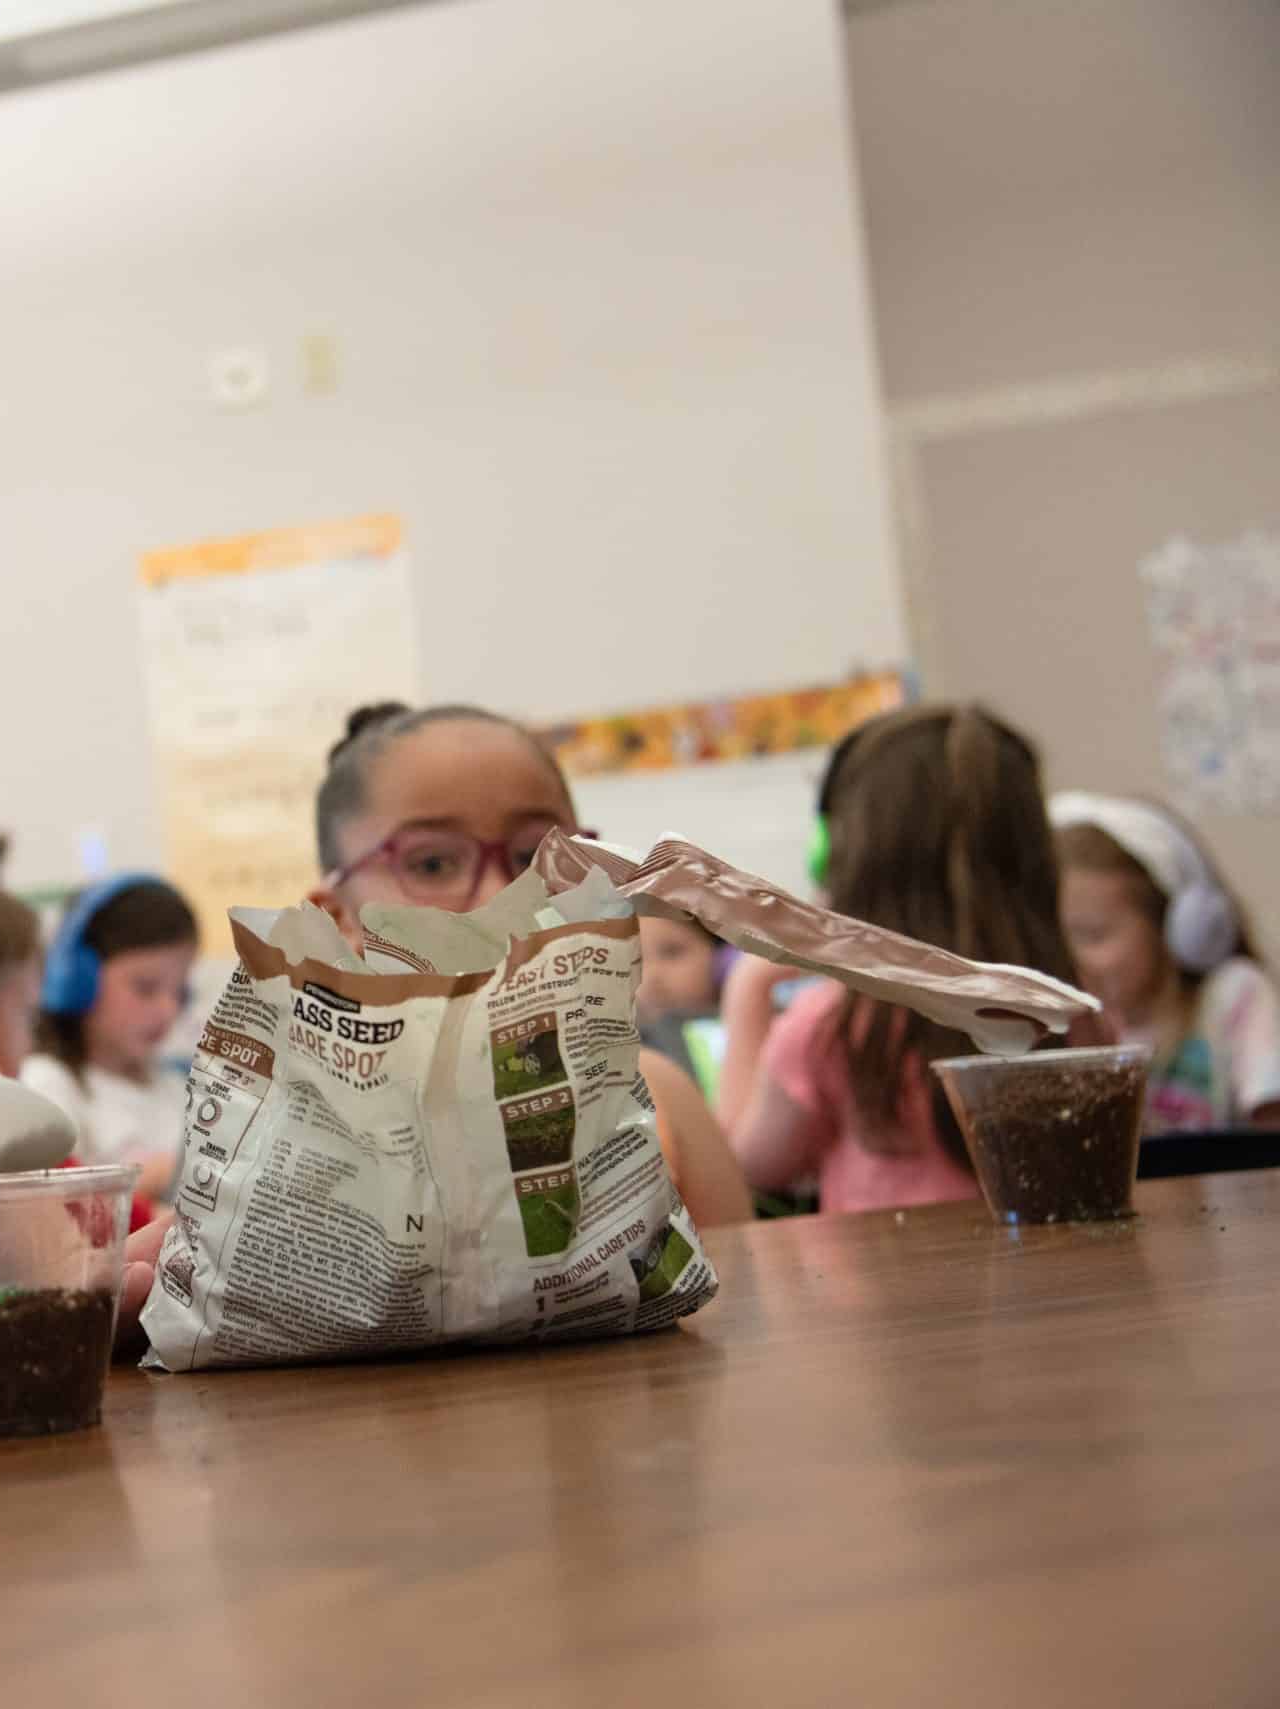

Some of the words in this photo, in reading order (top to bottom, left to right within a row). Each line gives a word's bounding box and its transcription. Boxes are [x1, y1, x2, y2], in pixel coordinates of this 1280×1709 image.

[293, 996, 333, 1033] ASS
[337, 1018, 405, 1045] SEED
[497, 1020, 538, 1045] STEP
[542, 1016, 551, 1029] 1
[220, 1040, 262, 1067] SPOT
[332, 1041, 388, 1079] SPOT
[506, 1096, 553, 1118] STEP
[559, 1091, 570, 1104] 2
[520, 1172, 570, 1194] STEP
[406, 1214, 424, 1232] N
[533, 1254, 601, 1293] ADDITIONAL
[598, 1234, 626, 1262] CARE
[622, 1218, 647, 1245] TIPS
